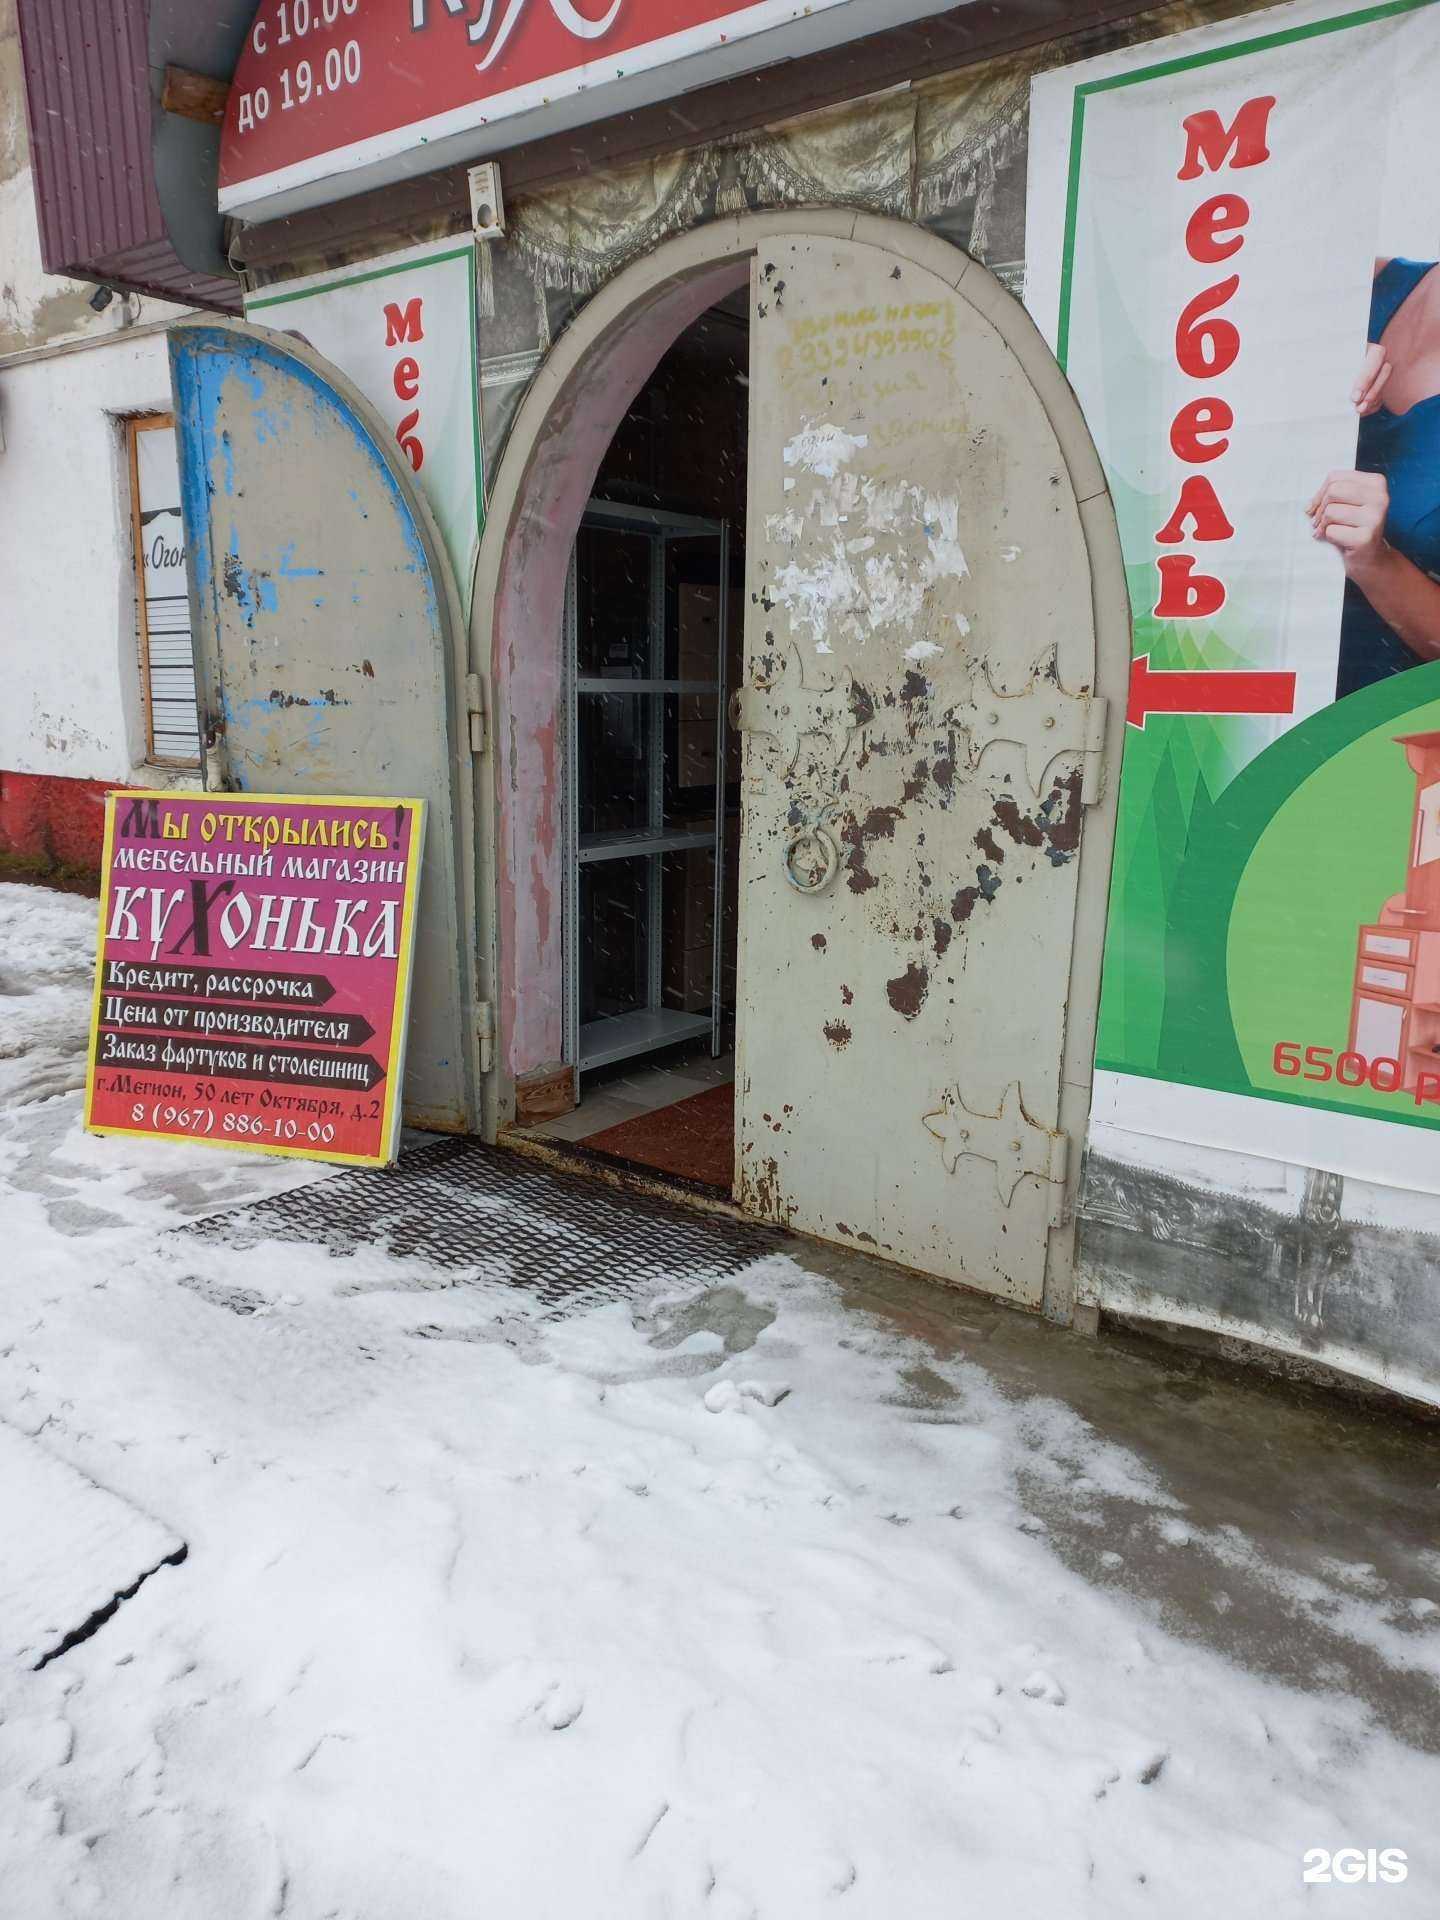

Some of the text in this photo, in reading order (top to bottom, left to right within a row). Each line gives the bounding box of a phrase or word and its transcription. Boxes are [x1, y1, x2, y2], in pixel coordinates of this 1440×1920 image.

[238, 39, 362, 133] до 19.00
[1153, 95, 1277, 618] Мебель
[120, 799, 405, 857] Мы открылись!
[107, 961, 314, 1001] Кредит, рассрочка
[104, 996, 350, 1041] Цена от производителя
[102, 1034, 369, 1084] Заказ фартуков и столешниц
[1272, 1041, 1403, 1093] 6500
[131, 1103, 335, 1143] 8 (967) 886-10-00
[193, 1082, 216, 1101] 50
[220, 1089, 254, 1106] лет
[259, 1088, 345, 1118] Октября,
